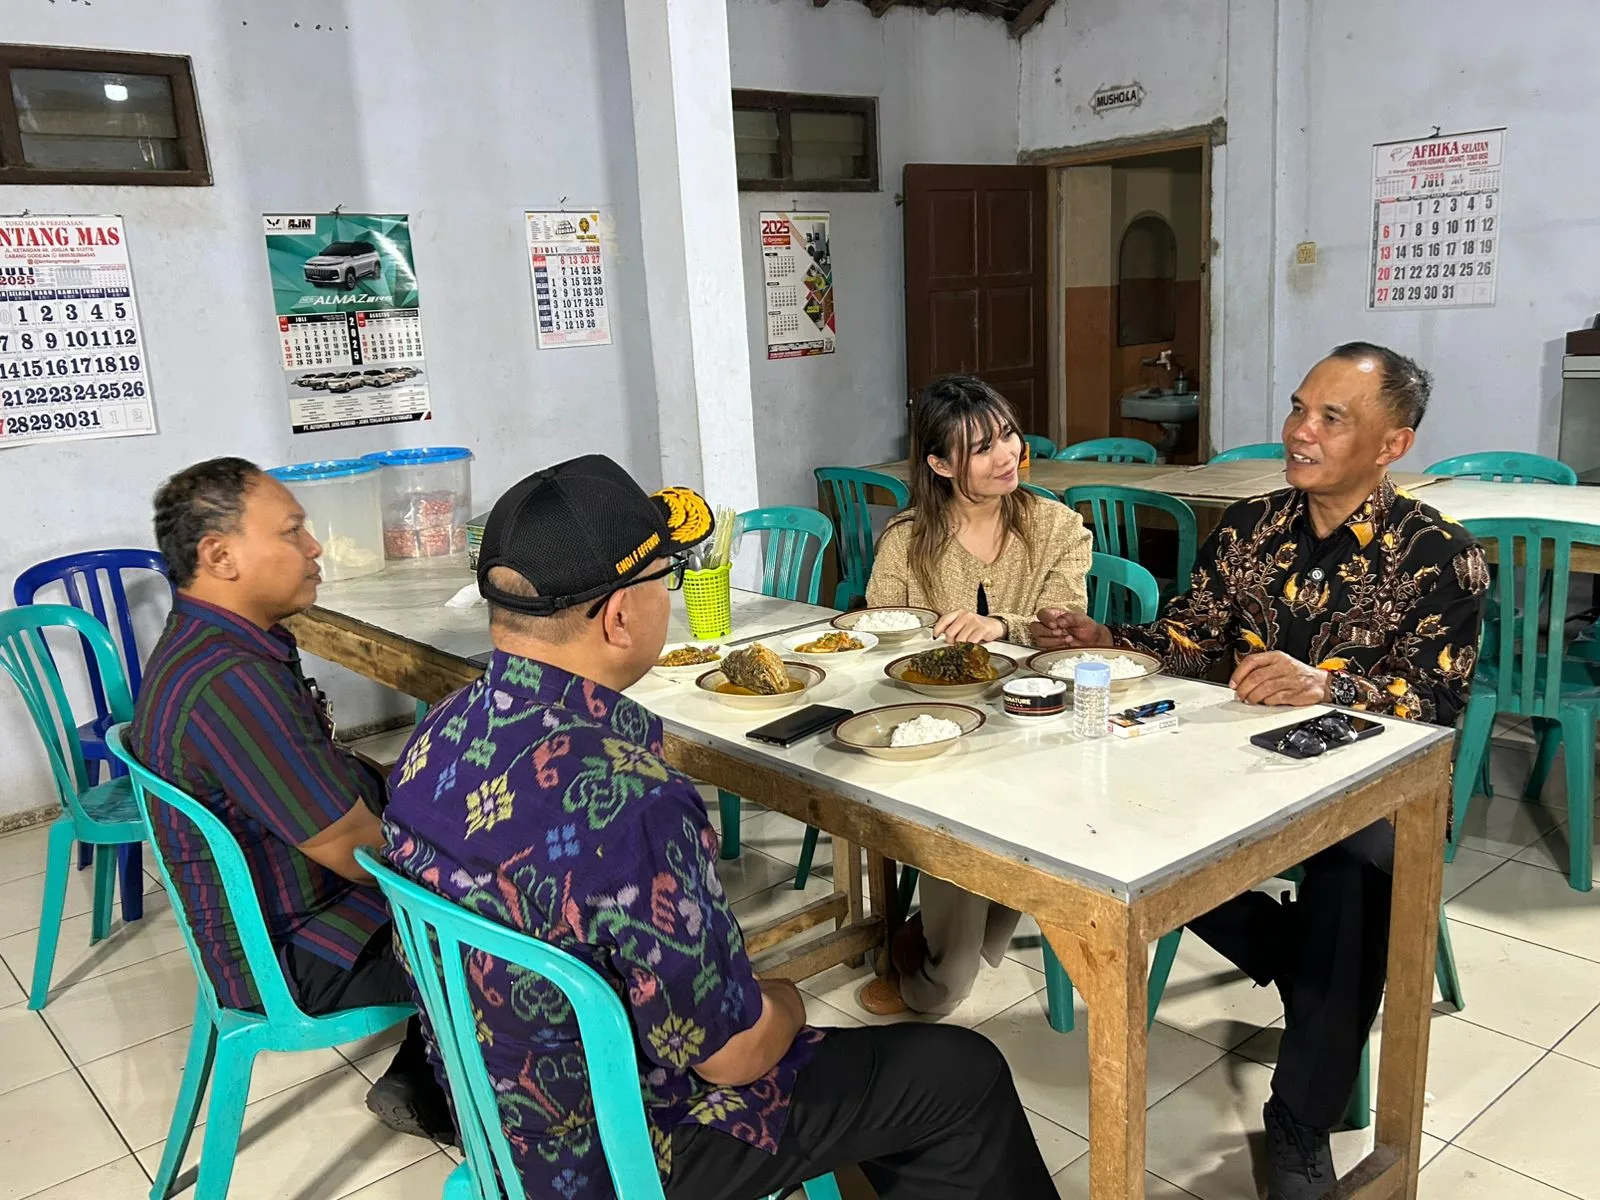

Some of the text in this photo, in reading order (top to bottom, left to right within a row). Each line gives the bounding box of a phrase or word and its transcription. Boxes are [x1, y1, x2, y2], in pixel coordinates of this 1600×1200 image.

[1412, 142, 1488, 159] AFRIKA SELATAN
[1411, 176, 1418, 190] 7
[1421, 179, 1444, 188] JULI
[1417, 196, 1492, 214] 1 2 3 4 5
[288, 219, 310, 228] AJM
[762, 221, 789, 234] 2025
[1383, 218, 1494, 238] 6 7 8 9 10 11 12
[75, 227, 120, 246] MAS
[1380, 240, 1492, 260] 13 14 15 16 17 18 19
[560, 256, 600, 264] 6 13 20 27
[562, 266, 602, 276] 7 14 21 28
[1378, 262, 1491, 280] 20 21 22 23 24 25 26
[552, 278, 556, 286] 1
[562, 278, 567, 286] 8
[572, 278, 580, 286] 15
[582, 277, 592, 285] 22
[312, 294, 368, 305] ALMAZ
[552, 287, 603, 297] 2 9 16 23 30
[1377, 286, 1454, 302] 27 28 29 30 31
[554, 300, 558, 308] 3
[563, 300, 571, 308] 10
[574, 299, 582, 307] 17
[585, 298, 594, 306] 24
[596, 298, 604, 306] 31
[18, 303, 126, 322] 1 2 3 4 5
[555, 311, 560, 319] 4
[564, 310, 572, 318] 11
[575, 310, 583, 318] 18
[586, 309, 594, 317] 25
[556, 320, 596, 330] 5 12 19 26
[0, 329, 136, 351] 7 8 9 10 11 12
[348, 317, 360, 360] 2025
[0, 355, 140, 379] 14 15 16 17 18 19
[2, 381, 144, 406] 21 22 23 24 25 26
[7, 416, 29, 434] 28
[30, 414, 52, 431] 29
[54, 412, 77, 429] 30
[78, 410, 100, 428] 31
[632, 550, 638, 562] F
